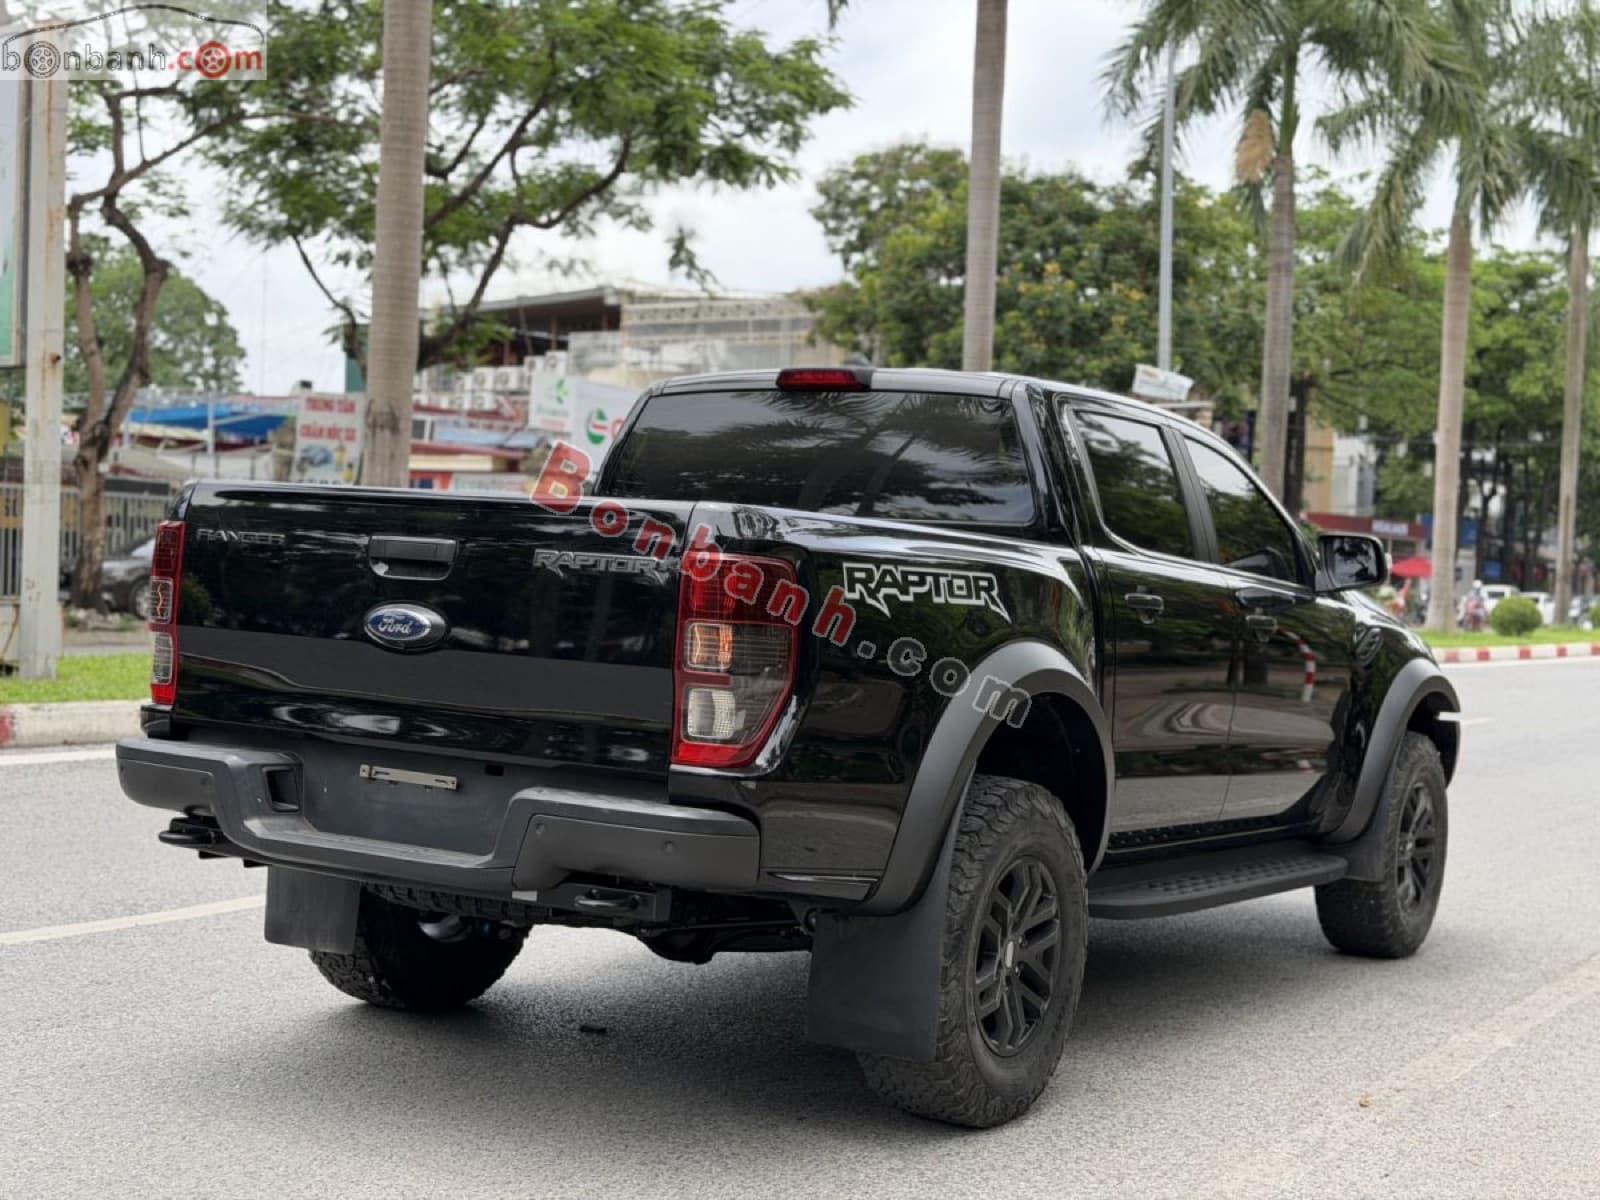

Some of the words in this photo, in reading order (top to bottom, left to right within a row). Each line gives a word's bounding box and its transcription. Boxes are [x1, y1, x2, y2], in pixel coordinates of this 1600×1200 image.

[196, 528, 286, 545] RANGER
[533, 548, 670, 585] RAPTOR
[842, 562, 1012, 624] RAPTOR
[378, 615, 413, 635] Ford
